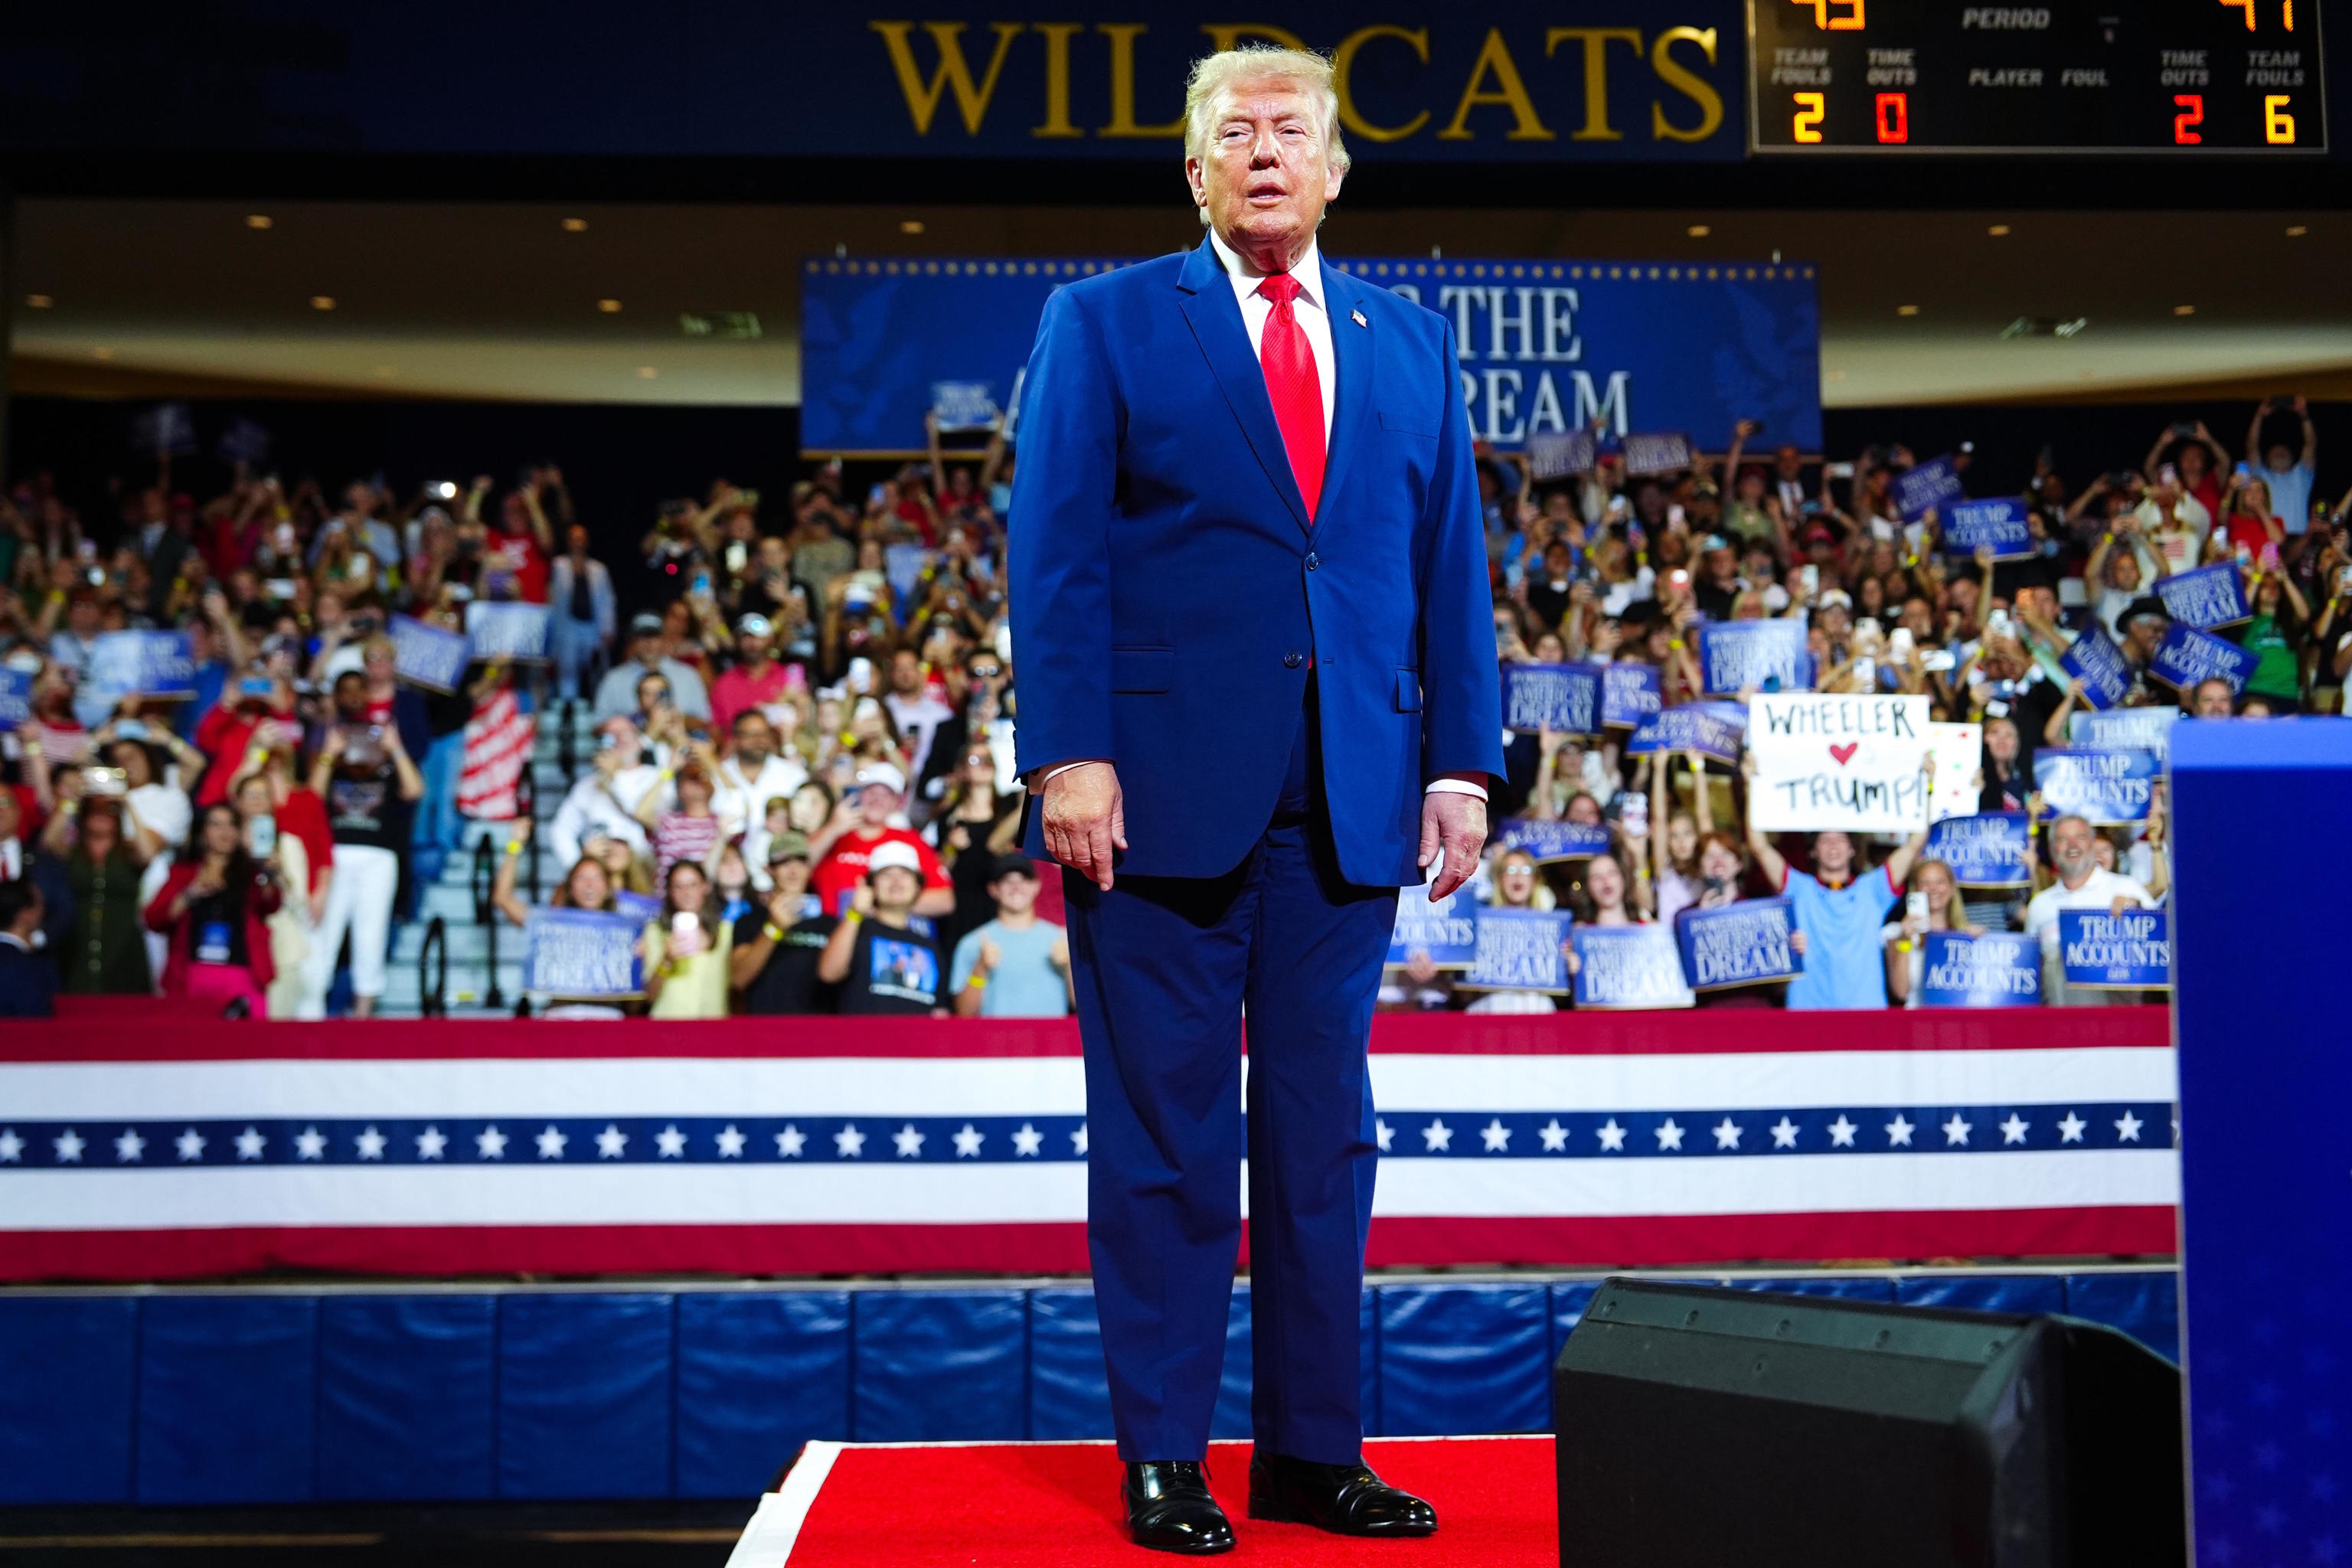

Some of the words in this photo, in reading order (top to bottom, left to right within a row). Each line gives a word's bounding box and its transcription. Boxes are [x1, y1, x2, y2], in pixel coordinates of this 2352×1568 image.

[1962, 8, 2051, 29] PERIOD
[1775, 48, 1829, 66] TEAM
[1868, 49, 1915, 66] TIME
[2161, 50, 2208, 67] TIME
[2248, 51, 2300, 67] TEAM
[1771, 67, 1831, 85] FOULS
[1867, 67, 1916, 86] OUTS
[1968, 67, 2043, 86] PLAYER
[2061, 67, 2109, 86] FOUL
[2161, 68, 2210, 86] OUTS
[2246, 69, 2304, 86] FOULS
[1793, 92, 1824, 143] 2
[1876, 93, 1908, 143] 0
[2174, 94, 2203, 144] 2
[2265, 94, 2295, 144] 6
[1439, 285, 1582, 361] THE
[1953, 505, 2011, 527] TRUMP
[1945, 521, 2028, 546] ACCOUNTS
[2184, 630, 2242, 669] TRUMP
[1766, 700, 1914, 738] WHEELER
[2089, 717, 2160, 740] TRUMP
[2055, 754, 2132, 779] TRUMP
[2043, 777, 2150, 804] ACCOUNTS
[1941, 817, 2009, 841] TRUMP
[1395, 892, 1457, 918] RUMP
[2079, 916, 2157, 942] TRUMP
[1695, 944, 1792, 985] DREAM
[1944, 939, 2020, 965] TRUMP
[2066, 940, 2170, 968] ACCOUNTS
[1466, 953, 1557, 985] DREAM
[1926, 962, 2037, 995] ACCOUNTS
[1586, 971, 1685, 1003] DREAM
